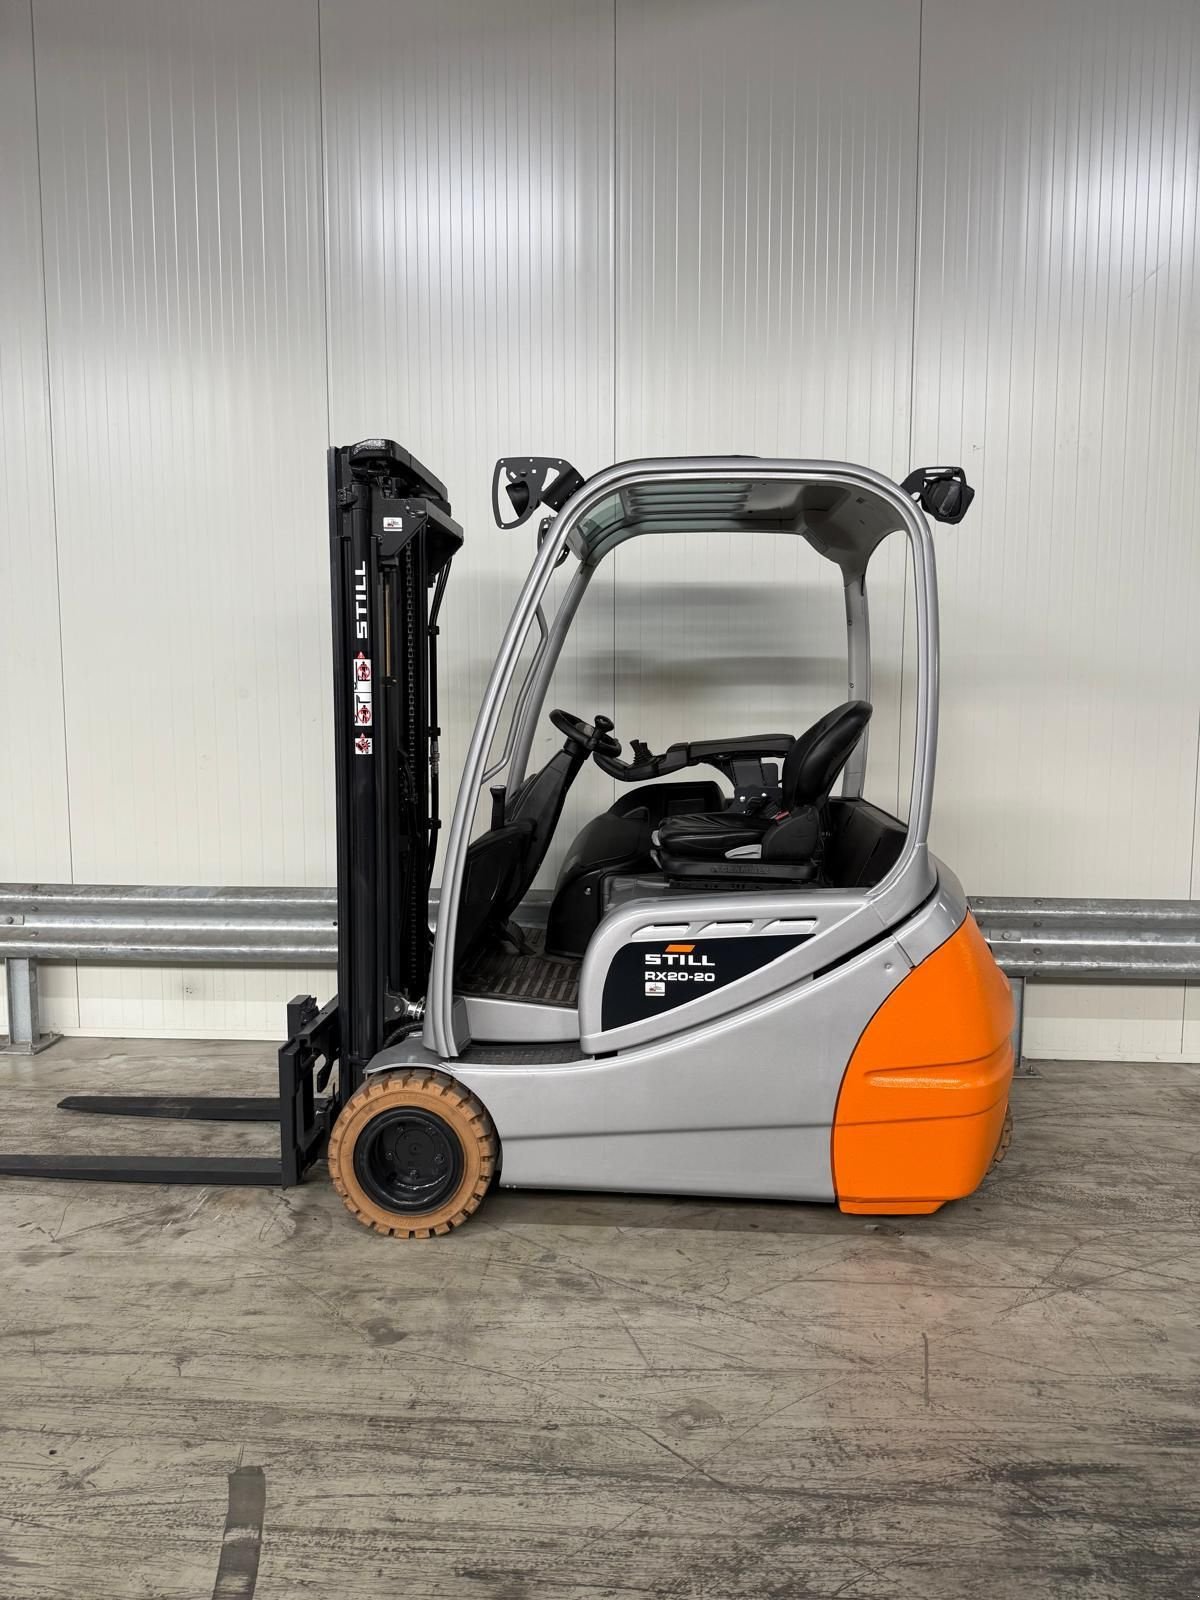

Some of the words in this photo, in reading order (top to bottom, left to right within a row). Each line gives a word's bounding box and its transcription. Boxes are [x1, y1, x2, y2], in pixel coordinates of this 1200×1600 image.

[354, 560, 368, 639] STILL
[644, 954, 716, 966] STILL
[644, 971, 716, 982] RX20-20
